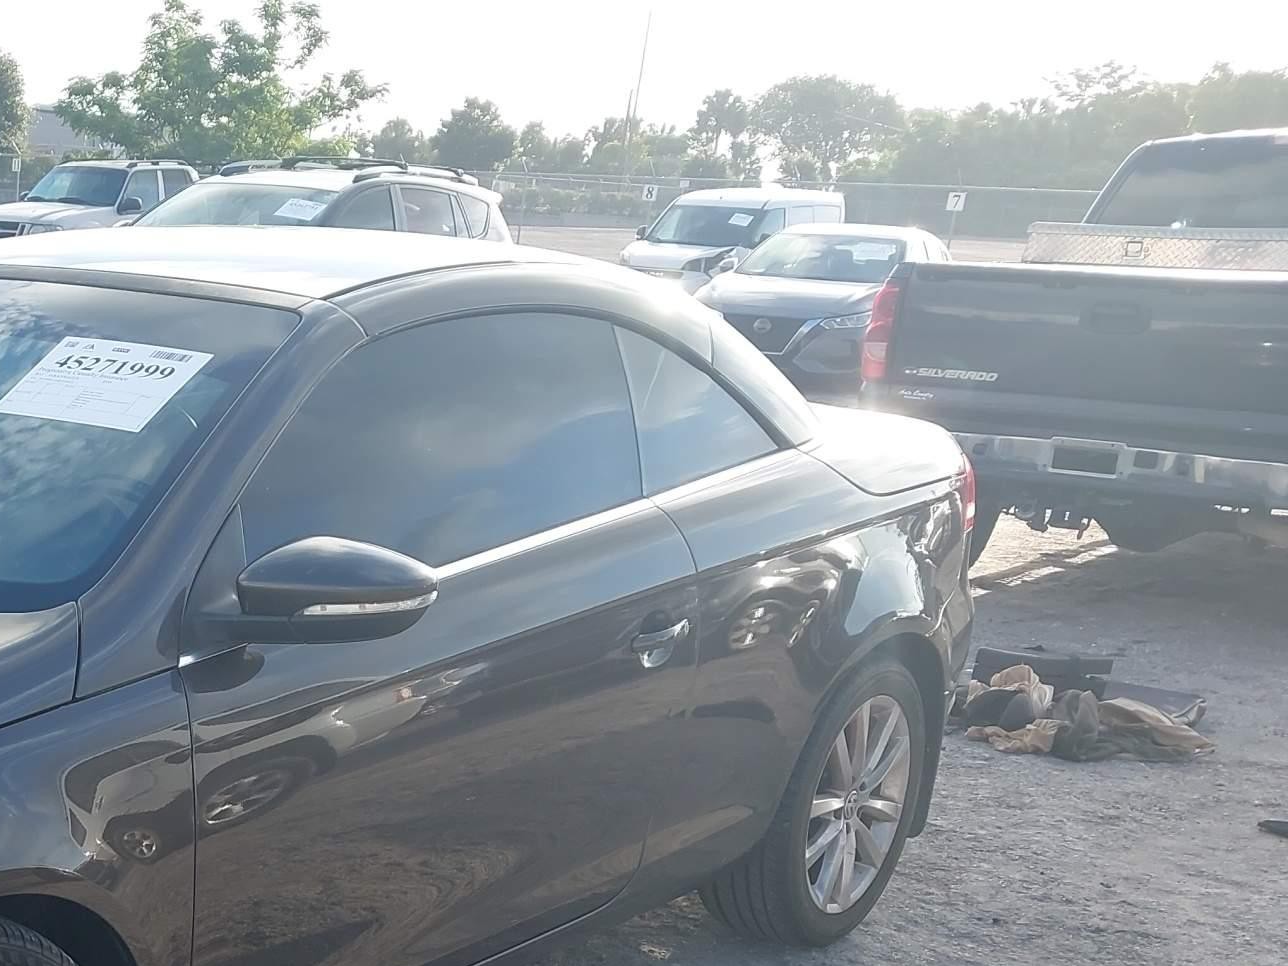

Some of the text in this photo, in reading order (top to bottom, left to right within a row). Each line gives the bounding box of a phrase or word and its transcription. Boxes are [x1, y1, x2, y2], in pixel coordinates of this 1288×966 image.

[645, 186, 654, 199] 8
[952, 194, 961, 209] 7
[55, 354, 176, 380] 45271999
[916, 367, 999, 381] SILVERADO
